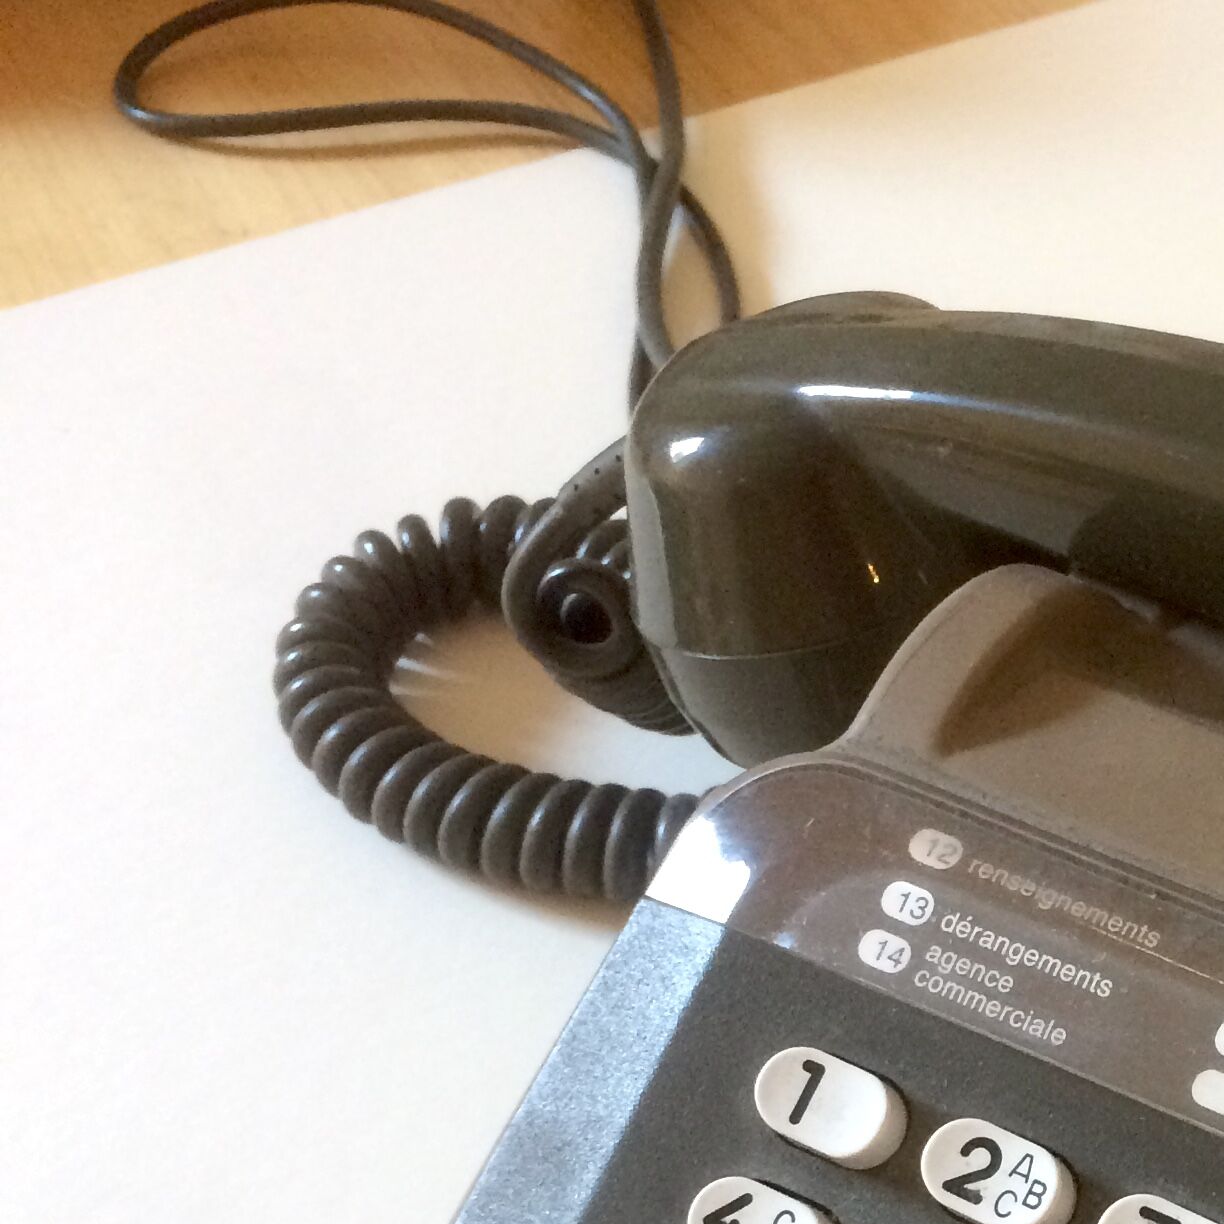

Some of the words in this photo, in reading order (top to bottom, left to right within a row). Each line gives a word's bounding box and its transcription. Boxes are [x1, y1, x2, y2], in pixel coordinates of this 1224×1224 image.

[925, 838, 960, 863] 12
[967, 857, 1162, 948] renseignements
[875, 940, 908, 969] 14
[925, 944, 1014, 993] agence
[898, 891, 930, 920] 13
[940, 912, 1114, 999] dérangements
[914, 968, 1068, 1047] commerciale
[788, 1059, 826, 1126] 1
[941, 1136, 1003, 1206] 2
